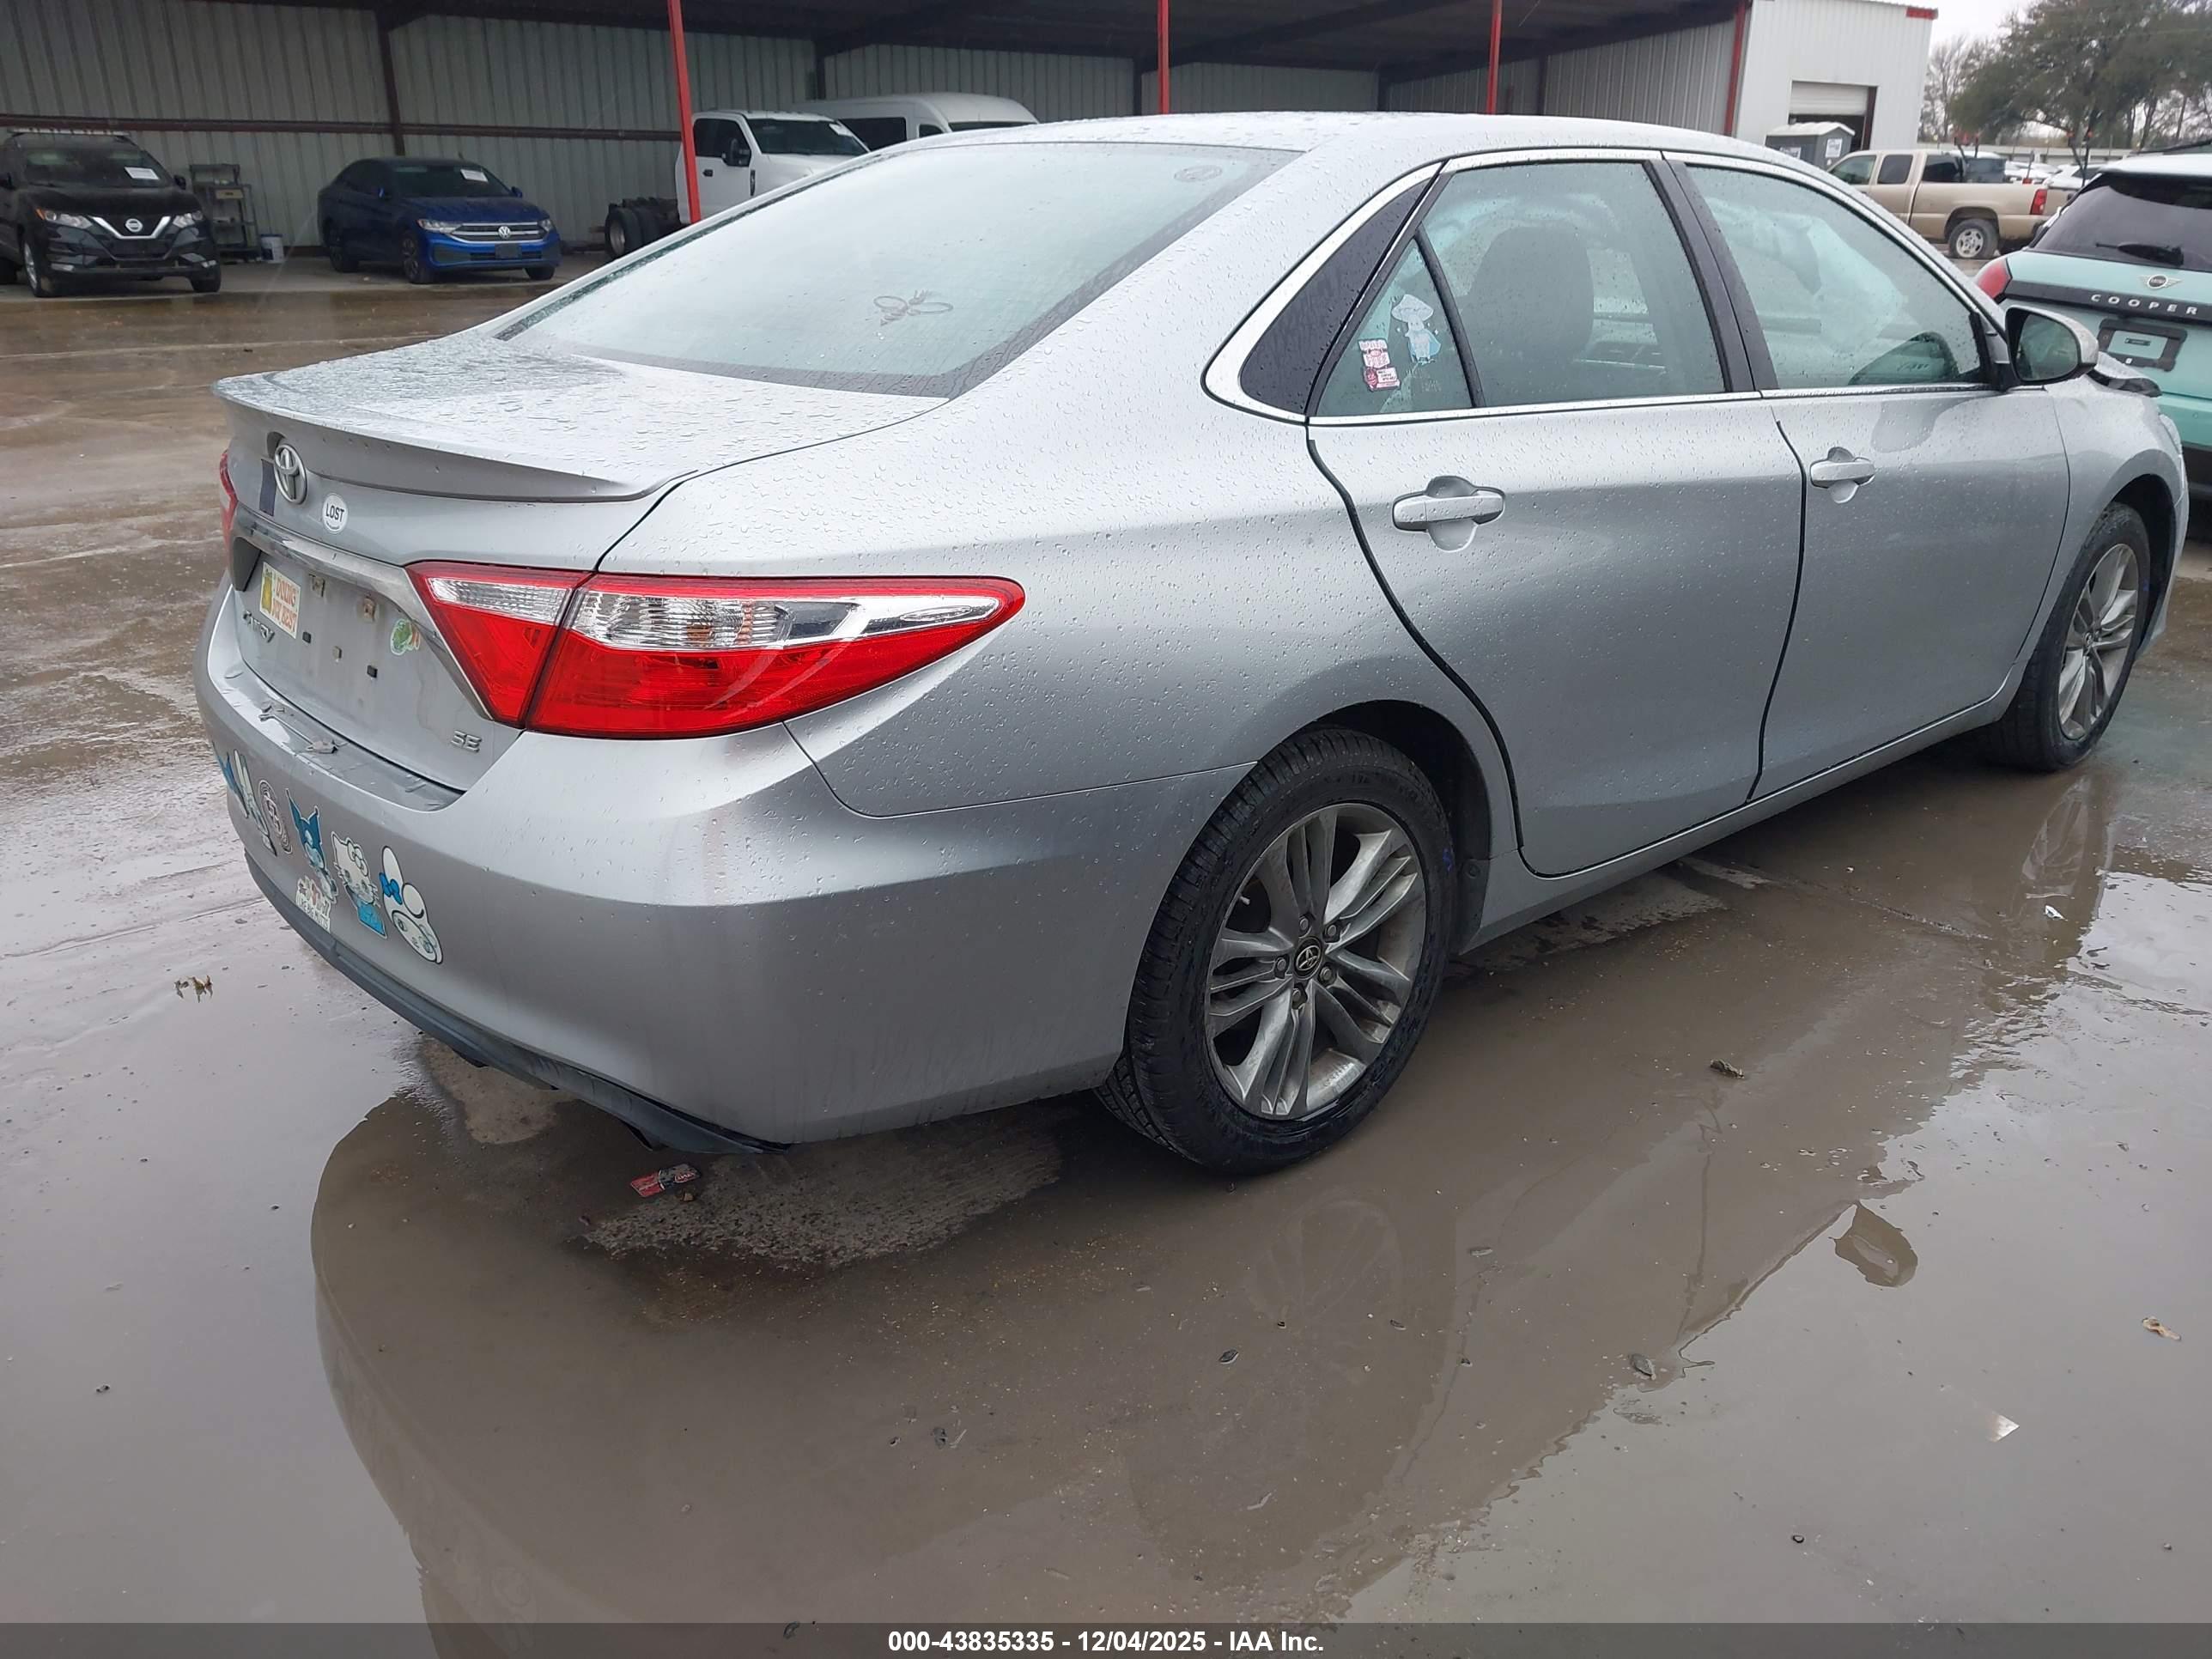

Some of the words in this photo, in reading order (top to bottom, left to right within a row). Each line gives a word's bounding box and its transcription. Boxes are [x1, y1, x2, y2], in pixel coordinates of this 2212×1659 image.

[2091, 294, 2197, 315] COOPER
[325, 502, 345, 523] LOST
[451, 730, 483, 753] SE
